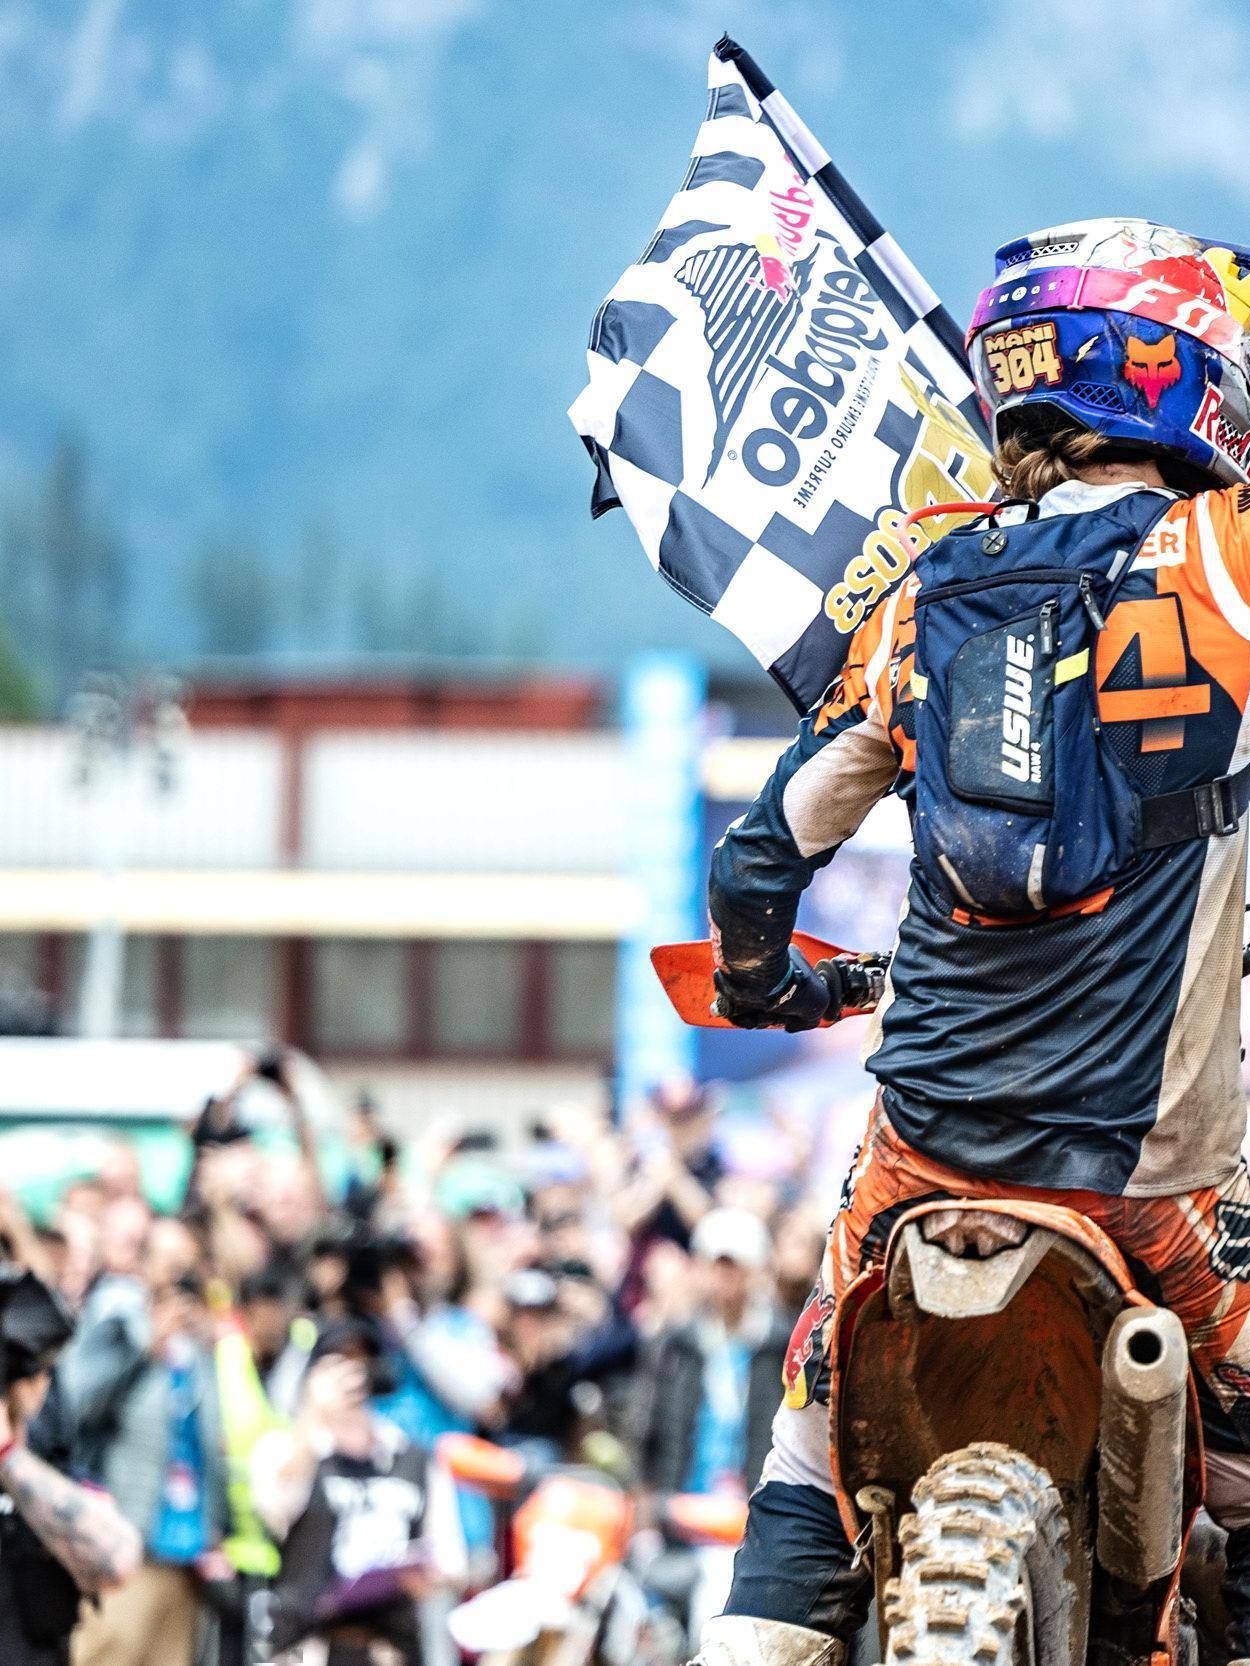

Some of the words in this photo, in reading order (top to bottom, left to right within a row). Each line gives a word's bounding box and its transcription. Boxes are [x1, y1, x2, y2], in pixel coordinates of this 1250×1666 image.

[1107, 278, 1243, 340] FO
[985, 325, 1055, 354] MANI
[988, 341, 1062, 394] 304
